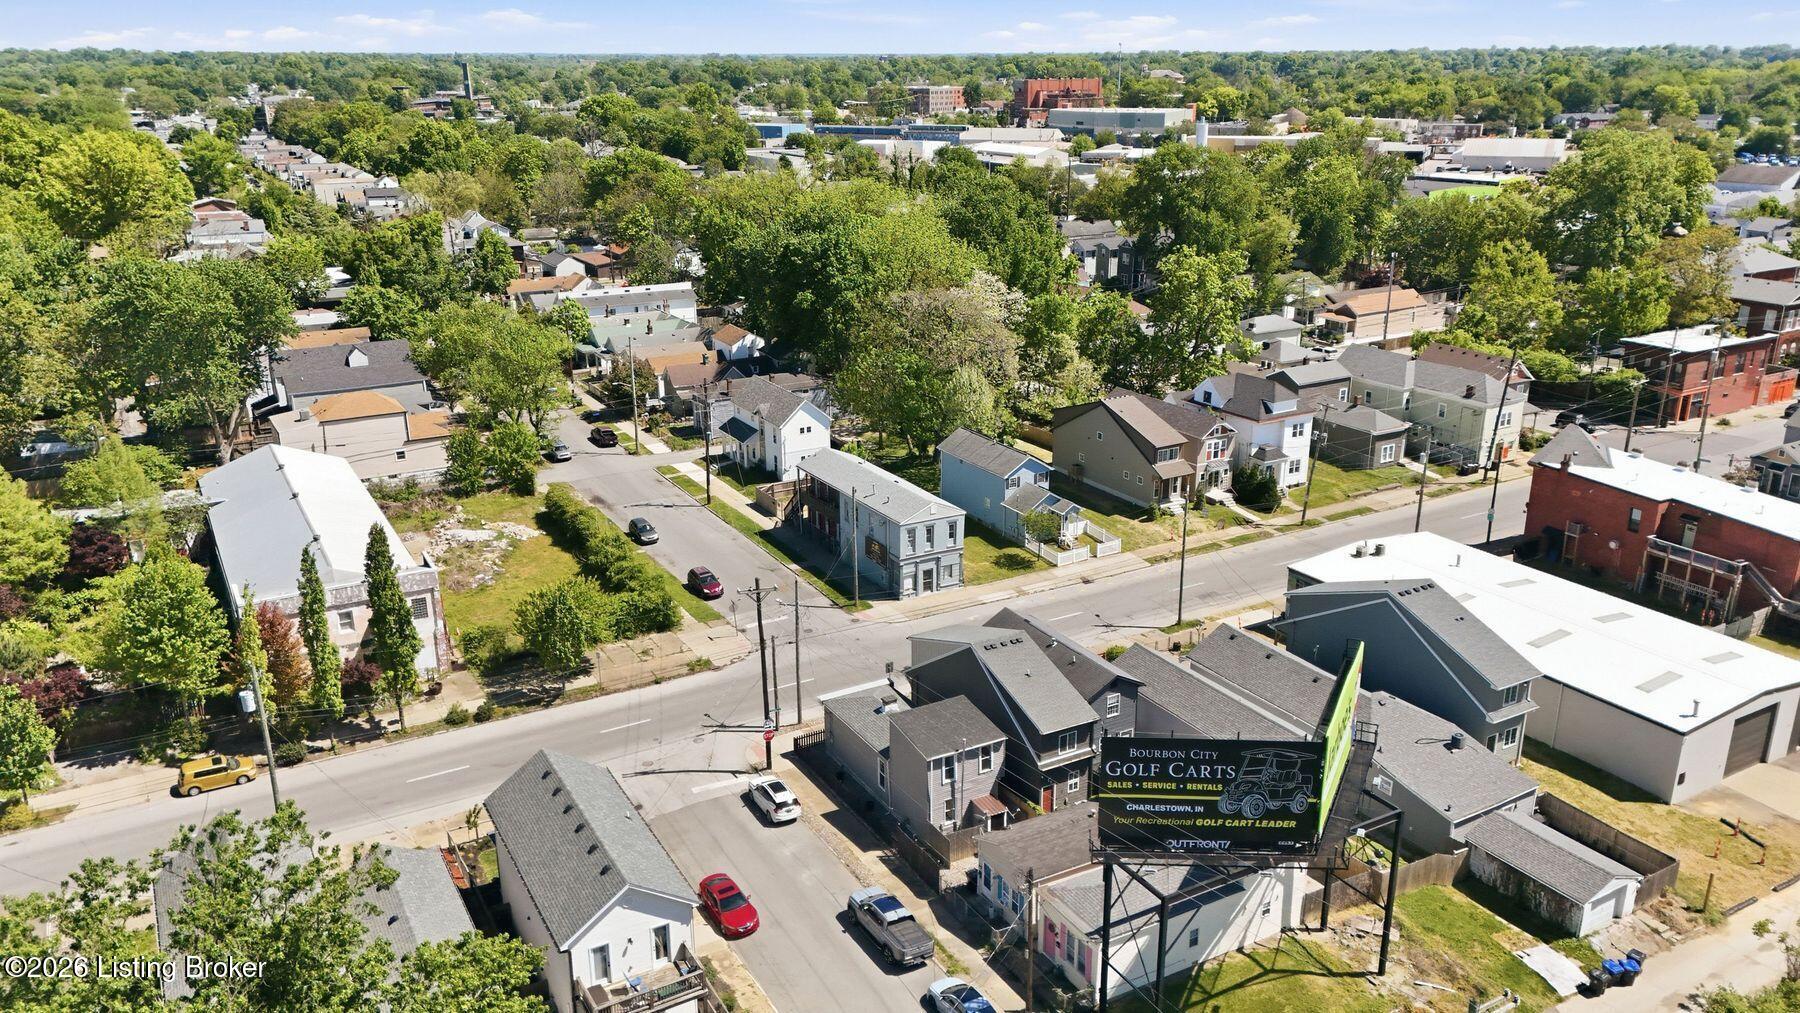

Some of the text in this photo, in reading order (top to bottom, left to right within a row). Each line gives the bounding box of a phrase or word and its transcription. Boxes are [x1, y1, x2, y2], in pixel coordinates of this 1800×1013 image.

[1129, 748, 1219, 760] BOURBON CITY
[1105, 760, 1236, 779] GOLF CARTS
[1107, 781, 1223, 791] SALES SERVICE RENTALS
[1126, 804, 1204, 813] CHARLESTOWN, IN
[1113, 816, 1297, 828] Your Recreational GOLF CART LEADER
